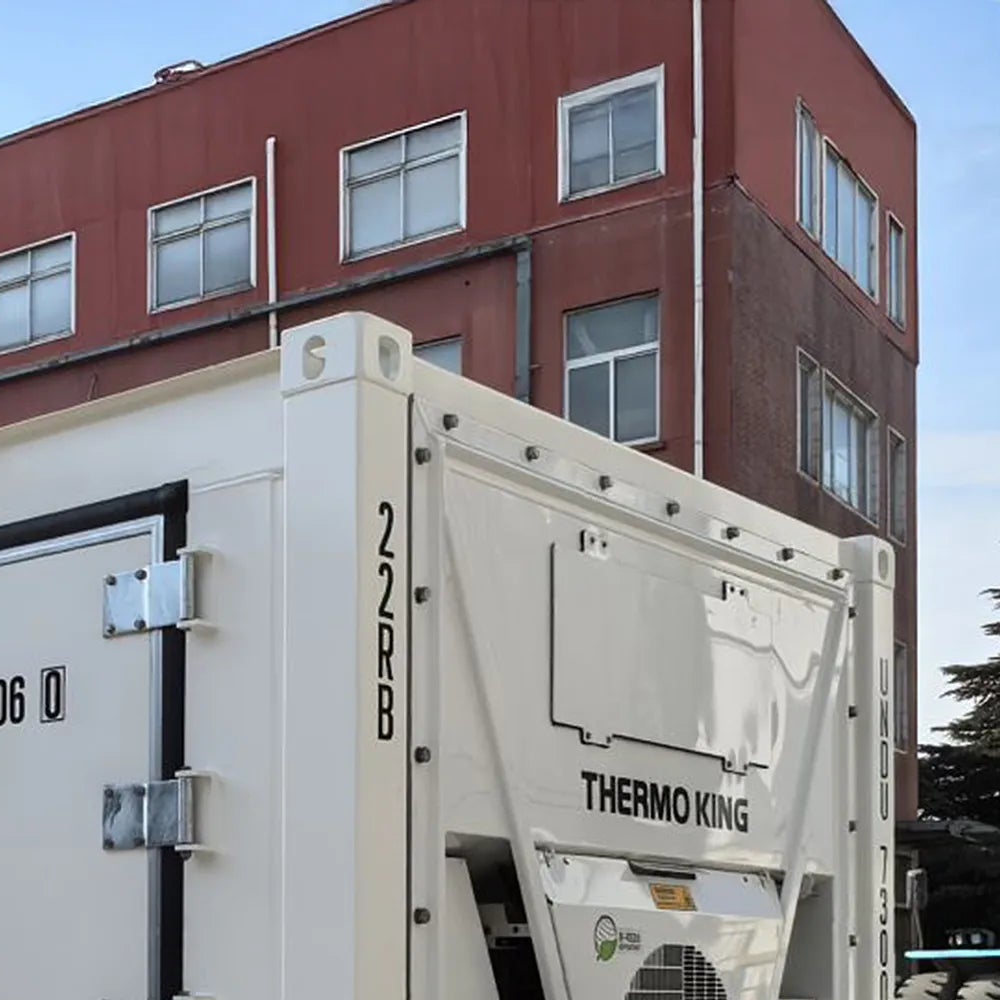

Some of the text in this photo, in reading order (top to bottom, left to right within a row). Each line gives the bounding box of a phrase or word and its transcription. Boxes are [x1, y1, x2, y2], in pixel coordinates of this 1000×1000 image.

[377, 501, 394, 740] 22RB
[45, 670, 61, 719] 0
[581, 770, 749, 833] THERMO KING
